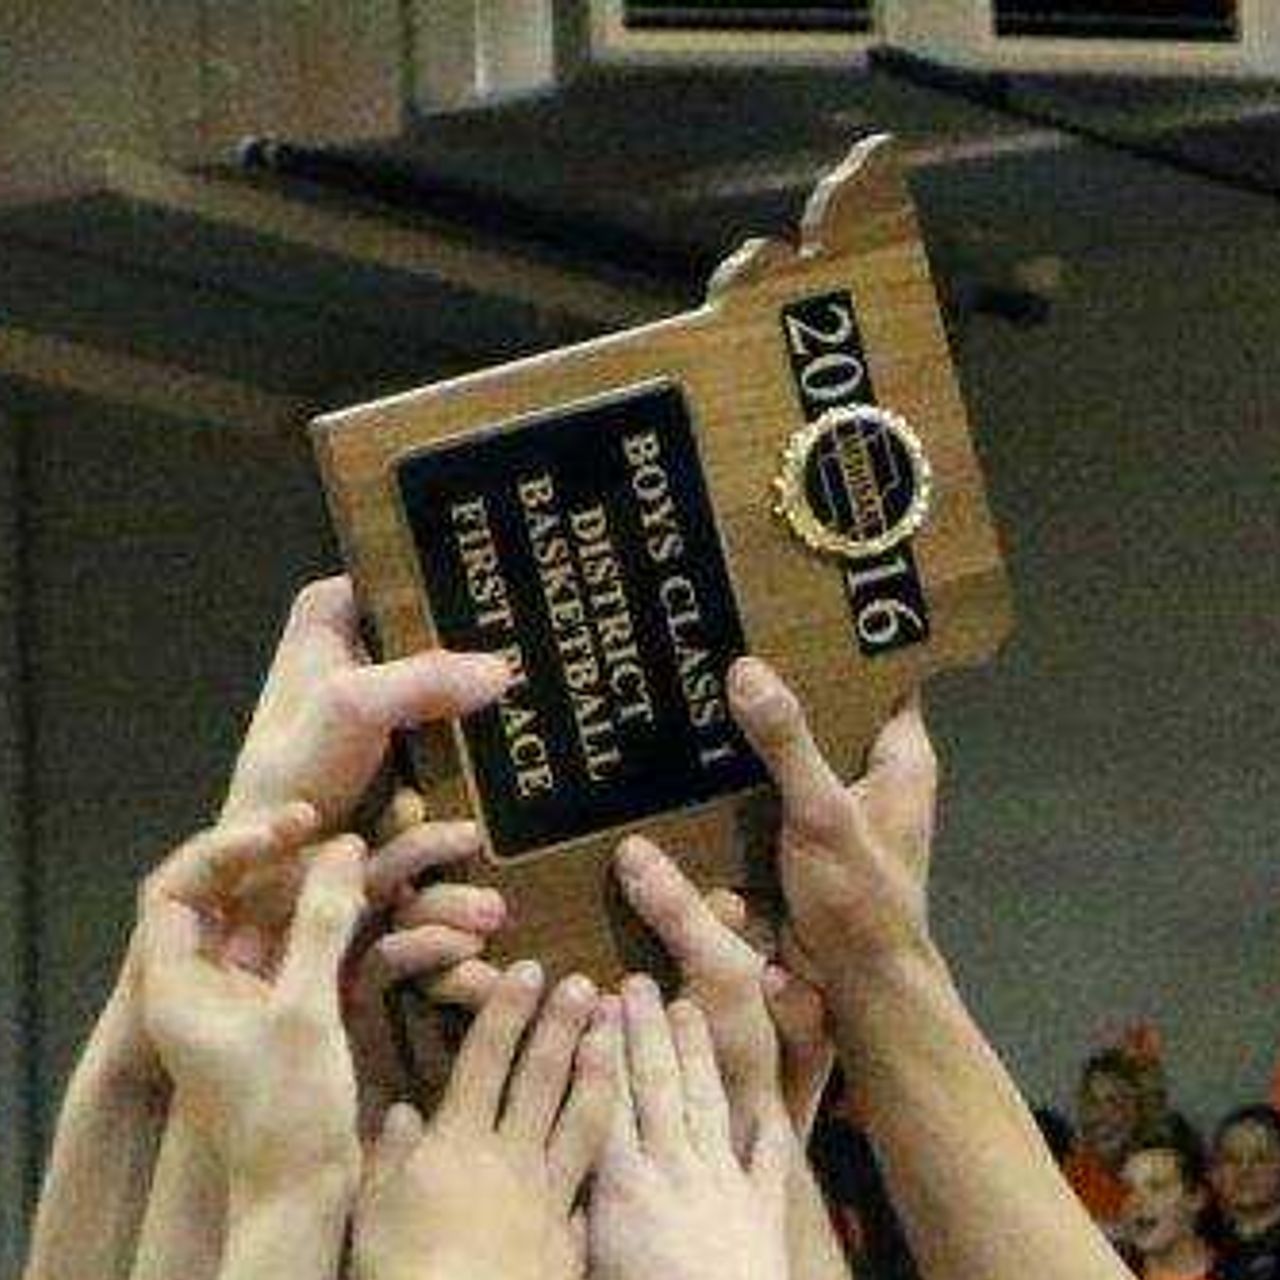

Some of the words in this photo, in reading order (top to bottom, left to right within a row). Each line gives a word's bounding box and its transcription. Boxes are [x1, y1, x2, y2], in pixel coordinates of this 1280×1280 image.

[452, 497, 515, 630] FIRST
[519, 473, 622, 782] BASKETBALL
[570, 501, 654, 724] DISTRICT
[624, 432, 684, 562] BOYS
[660, 575, 722, 727] CLASS
